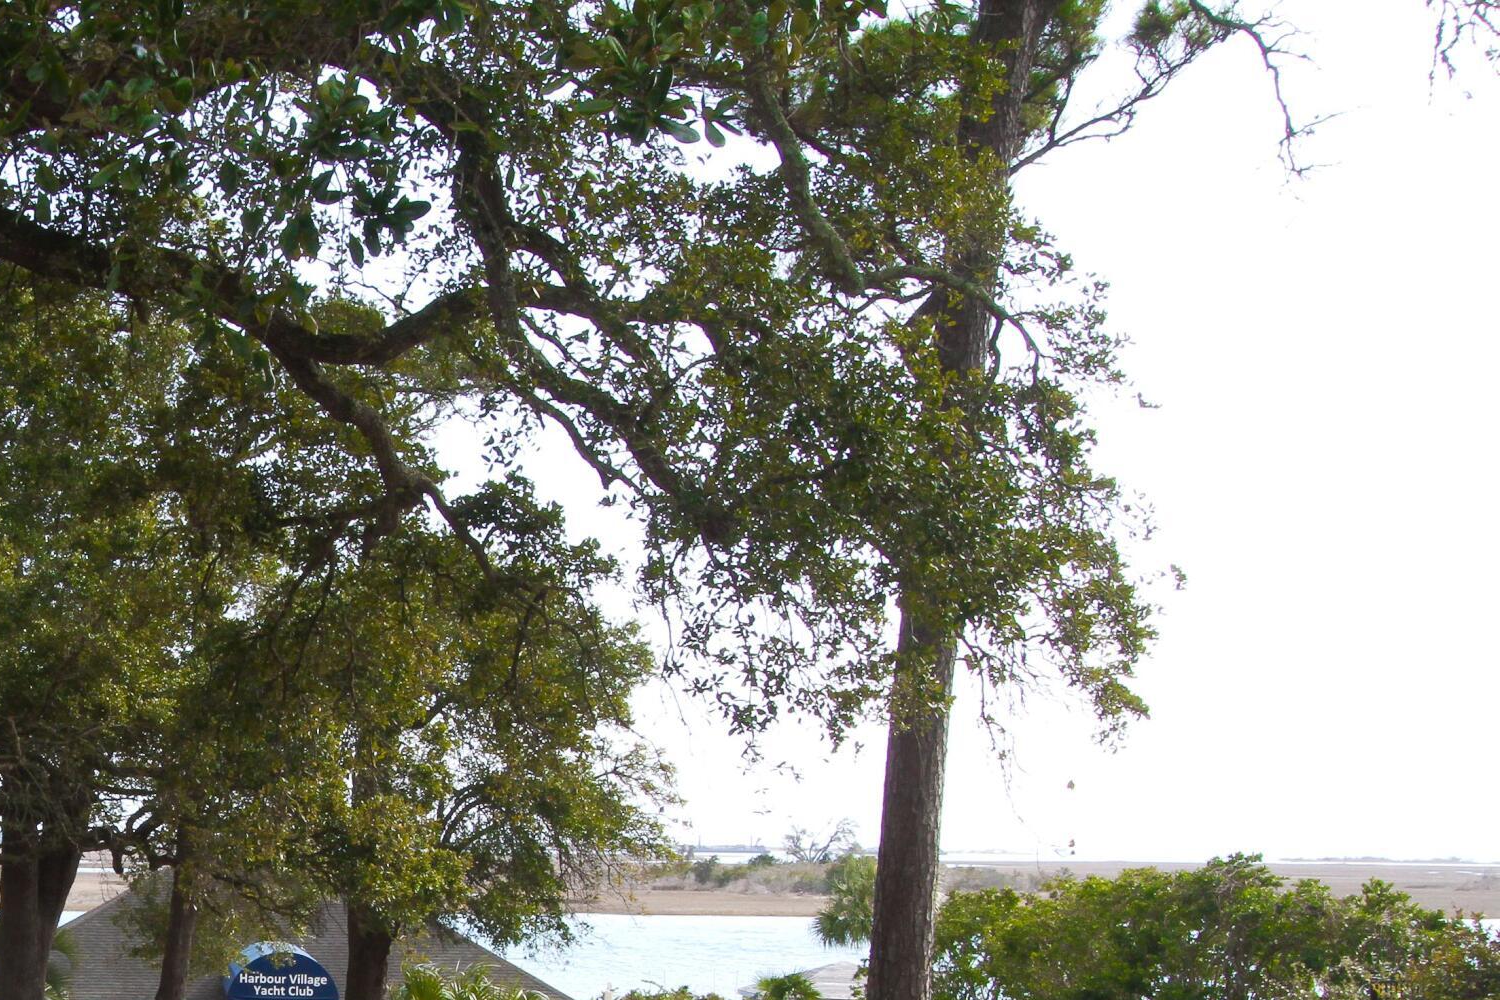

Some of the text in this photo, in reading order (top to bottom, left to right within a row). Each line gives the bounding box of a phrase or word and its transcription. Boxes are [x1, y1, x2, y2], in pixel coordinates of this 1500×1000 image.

[239, 973, 328, 987] Harbour Village
[253, 985, 314, 997] Yacht Club
